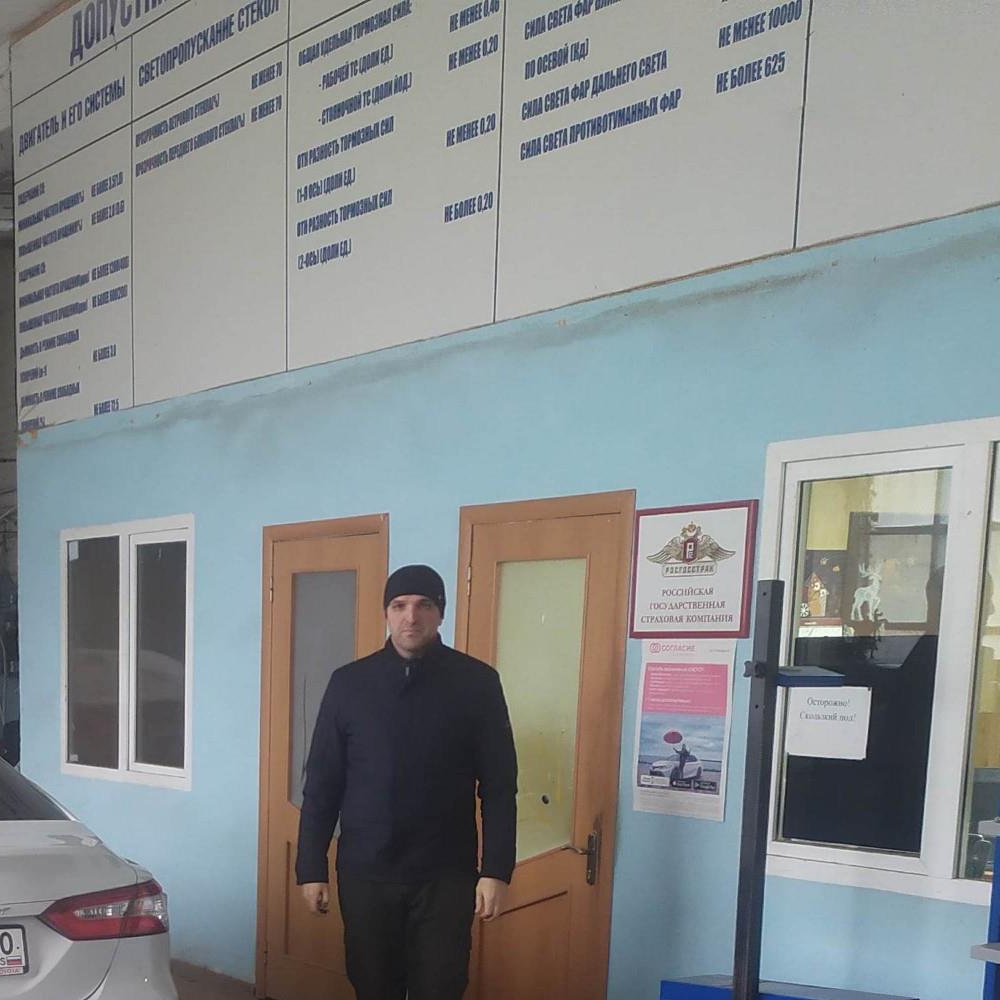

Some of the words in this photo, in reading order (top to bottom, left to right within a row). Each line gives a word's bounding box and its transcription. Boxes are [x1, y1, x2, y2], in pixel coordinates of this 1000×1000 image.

[70, 0, 166, 66] ДОПУС
[524, 15, 546, 41] СИЛА
[547, 3, 573, 31] СВЕТА
[718, 25, 731, 48] НЕ
[732, 12, 766, 43] МЕНЕЕ
[768, 0, 803, 30] 10000
[138, 13, 235, 87] СВЕТОПРОПУСКАНИЕ
[458, 41, 481, 67] МЕНЕЕ
[524, 59, 536, 80] ПО
[536, 43, 569, 75] ОСЕВОЙ
[521, 96, 543, 121] СИЛА
[544, 86, 570, 113] СВЕТА
[571, 79, 591, 102] ФАР
[591, 61, 638, 99] ДАЛЬНЕГО
[638, 50, 668, 78] СВЕТА
[716, 70, 729, 94] НЕ
[730, 59, 763, 90] БОЛЕЕ
[764, 51, 786, 78] 625
[68, 101, 83, 127] ЕГО
[84, 75, 126, 117] СИСТЕМЫ
[380, 115, 394, 137] СИЛ
[446, 128, 456, 148] НЕ
[456, 119, 479, 144] МЕНЕЕ
[520, 137, 542, 161] СИЛА
[542, 127, 569, 153] СВЕТА
[569, 96, 659, 145] ПРОТИВОТУМАННЫХ
[659, 88, 682, 113] ФАР
[379, 188, 393, 209] СИЛ
[444, 204, 453, 223] НЕ
[453, 197, 476, 220] БОЛЕЕ
[649, 600, 726, 610] ГОСУДАРСТВЕННАЯ
[661, 586, 714, 597] РОССИЙСКАЯ
[640, 615, 684, 624] СТРАХОВАЯ
[686, 614, 734, 623] КОМПАНИЯ
